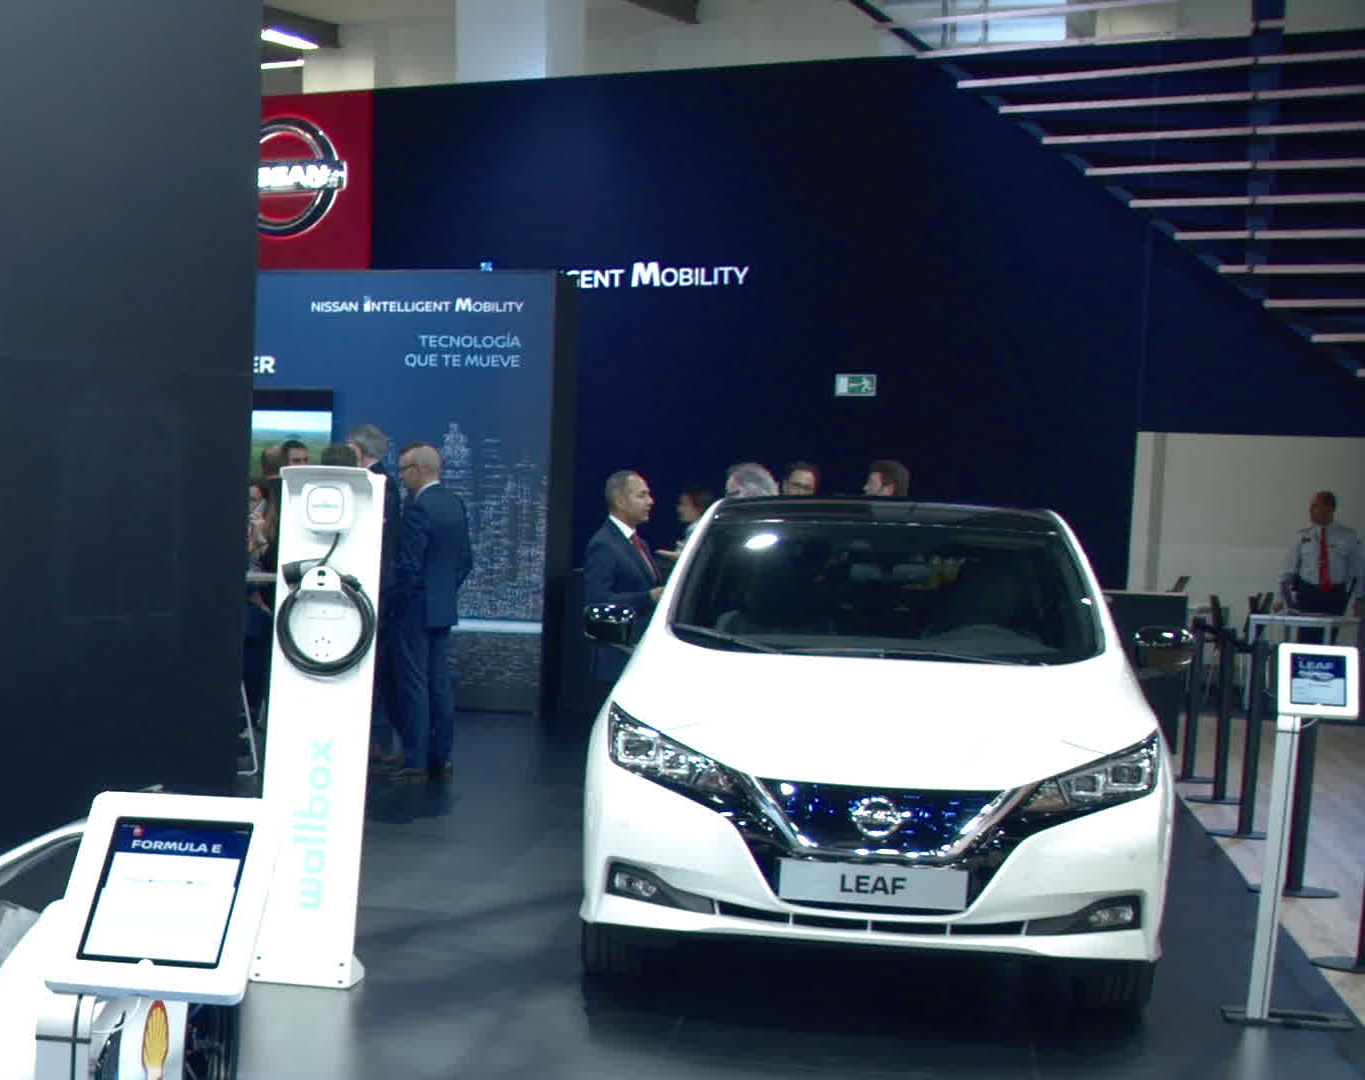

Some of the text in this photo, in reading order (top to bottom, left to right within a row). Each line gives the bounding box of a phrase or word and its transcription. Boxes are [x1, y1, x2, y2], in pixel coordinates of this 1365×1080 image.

[631, 262, 749, 287] MOBILITY
[311, 297, 524, 312] NISSAN INTELLIGENT MOBILITY
[419, 332, 521, 348] TECNOLOGÍA
[405, 354, 520, 367] QUE TE MUEVE
[292, 737, 334, 909] wallbox
[131, 839, 222, 854] FORMULA E
[840, 874, 907, 895] LEAF
